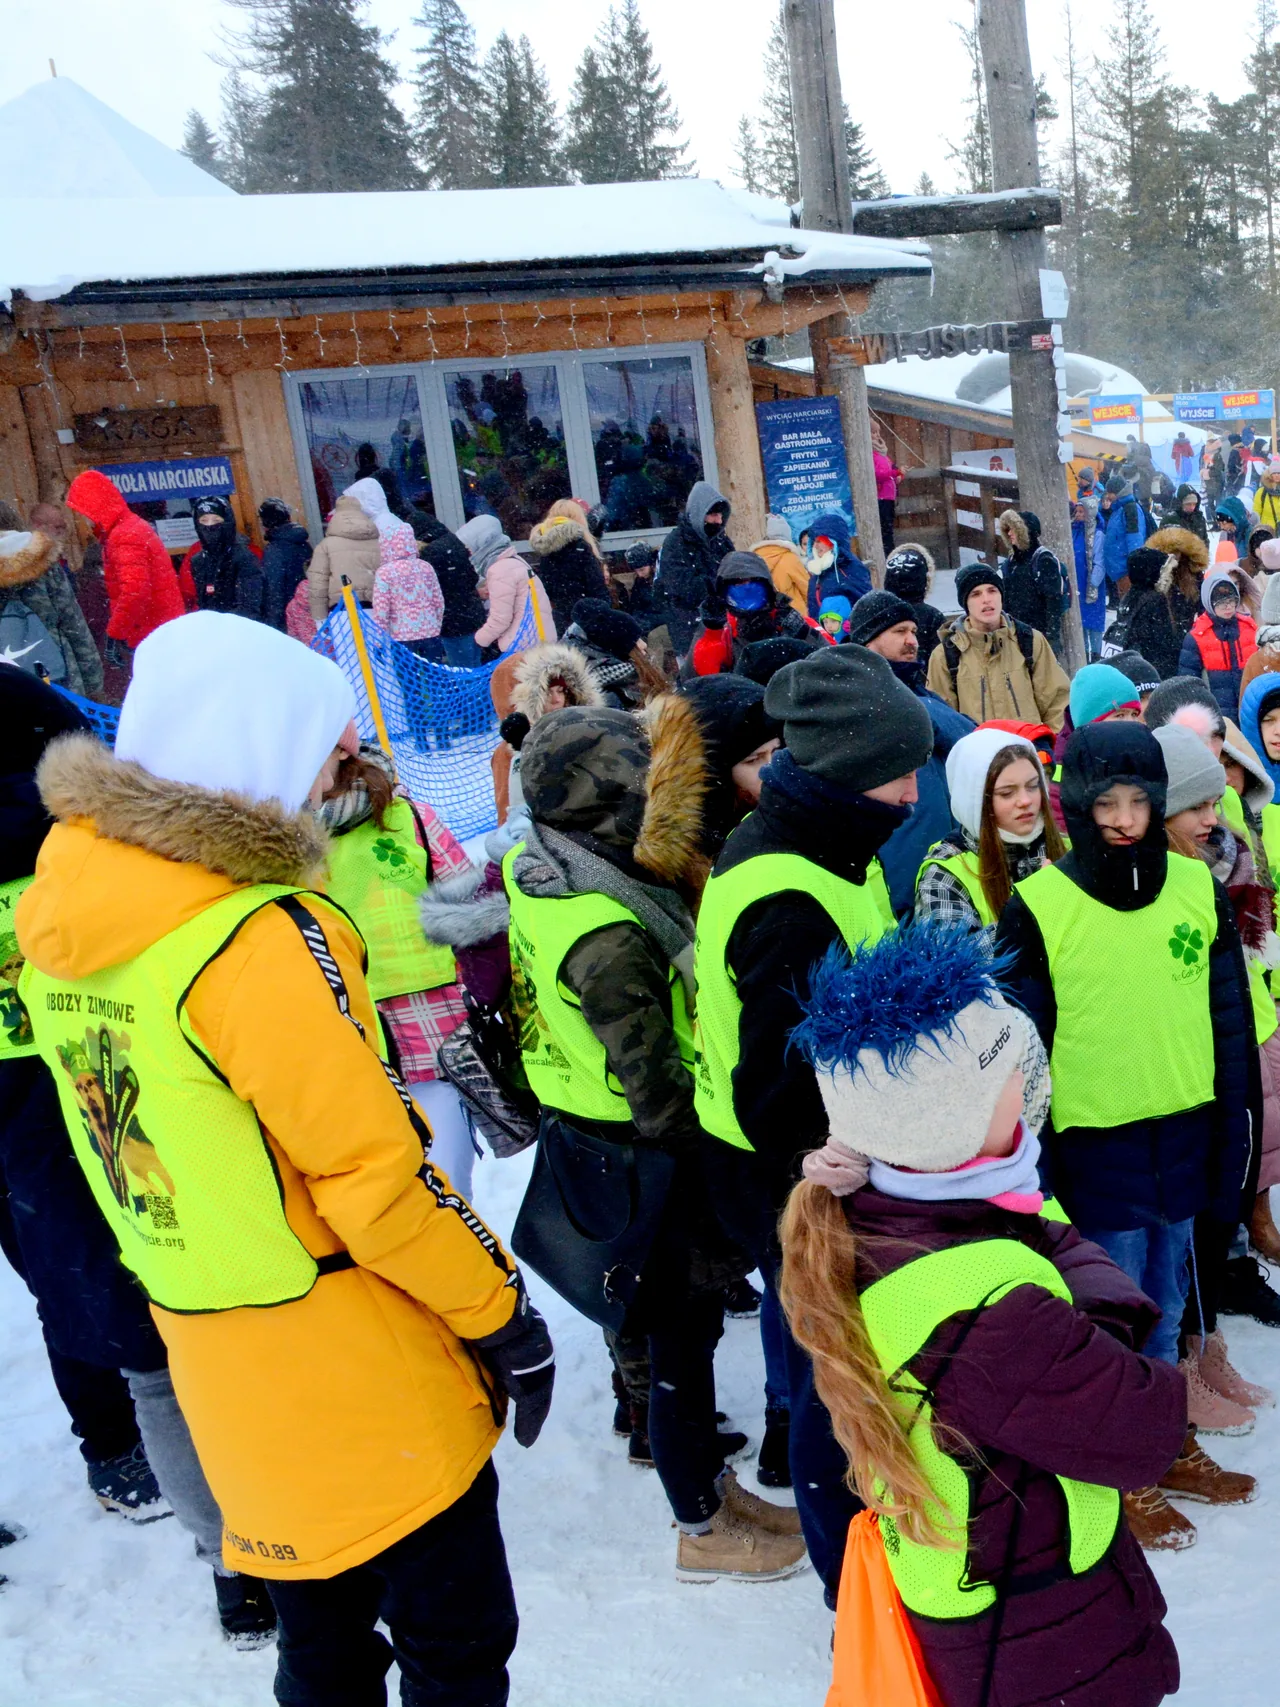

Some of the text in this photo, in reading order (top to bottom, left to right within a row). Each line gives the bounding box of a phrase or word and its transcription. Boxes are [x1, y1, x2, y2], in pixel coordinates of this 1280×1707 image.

[1224, 393, 1256, 407] WEJŚCIE
[793, 408, 832, 418] NARCIARSKI
[1092, 405, 1132, 420] WEJŚCIE
[1180, 407, 1215, 419] WYJŚCIE
[782, 431, 822, 441] BAR MAŁA
[775, 437, 832, 449] GASTRONOMIA
[791, 451, 818, 460] FRYTKI
[783, 460, 830, 472] ZAPIEKANKI
[108, 465, 229, 494] KOŁA NARCIARSKA
[779, 475, 806, 485] CIEPŁE
[812, 472, 837, 482] ZIMNE
[793, 482, 824, 491] NAPOJE
[781, 500, 842, 513] GRZANE TYSKIE
[46, 992, 135, 1024] OBOZY ZIMOWE
[979, 1024, 1012, 1070] Eisbär
[103, 1051, 112, 1095] SPORT
[256, 1540, 298, 1561] 0.89
